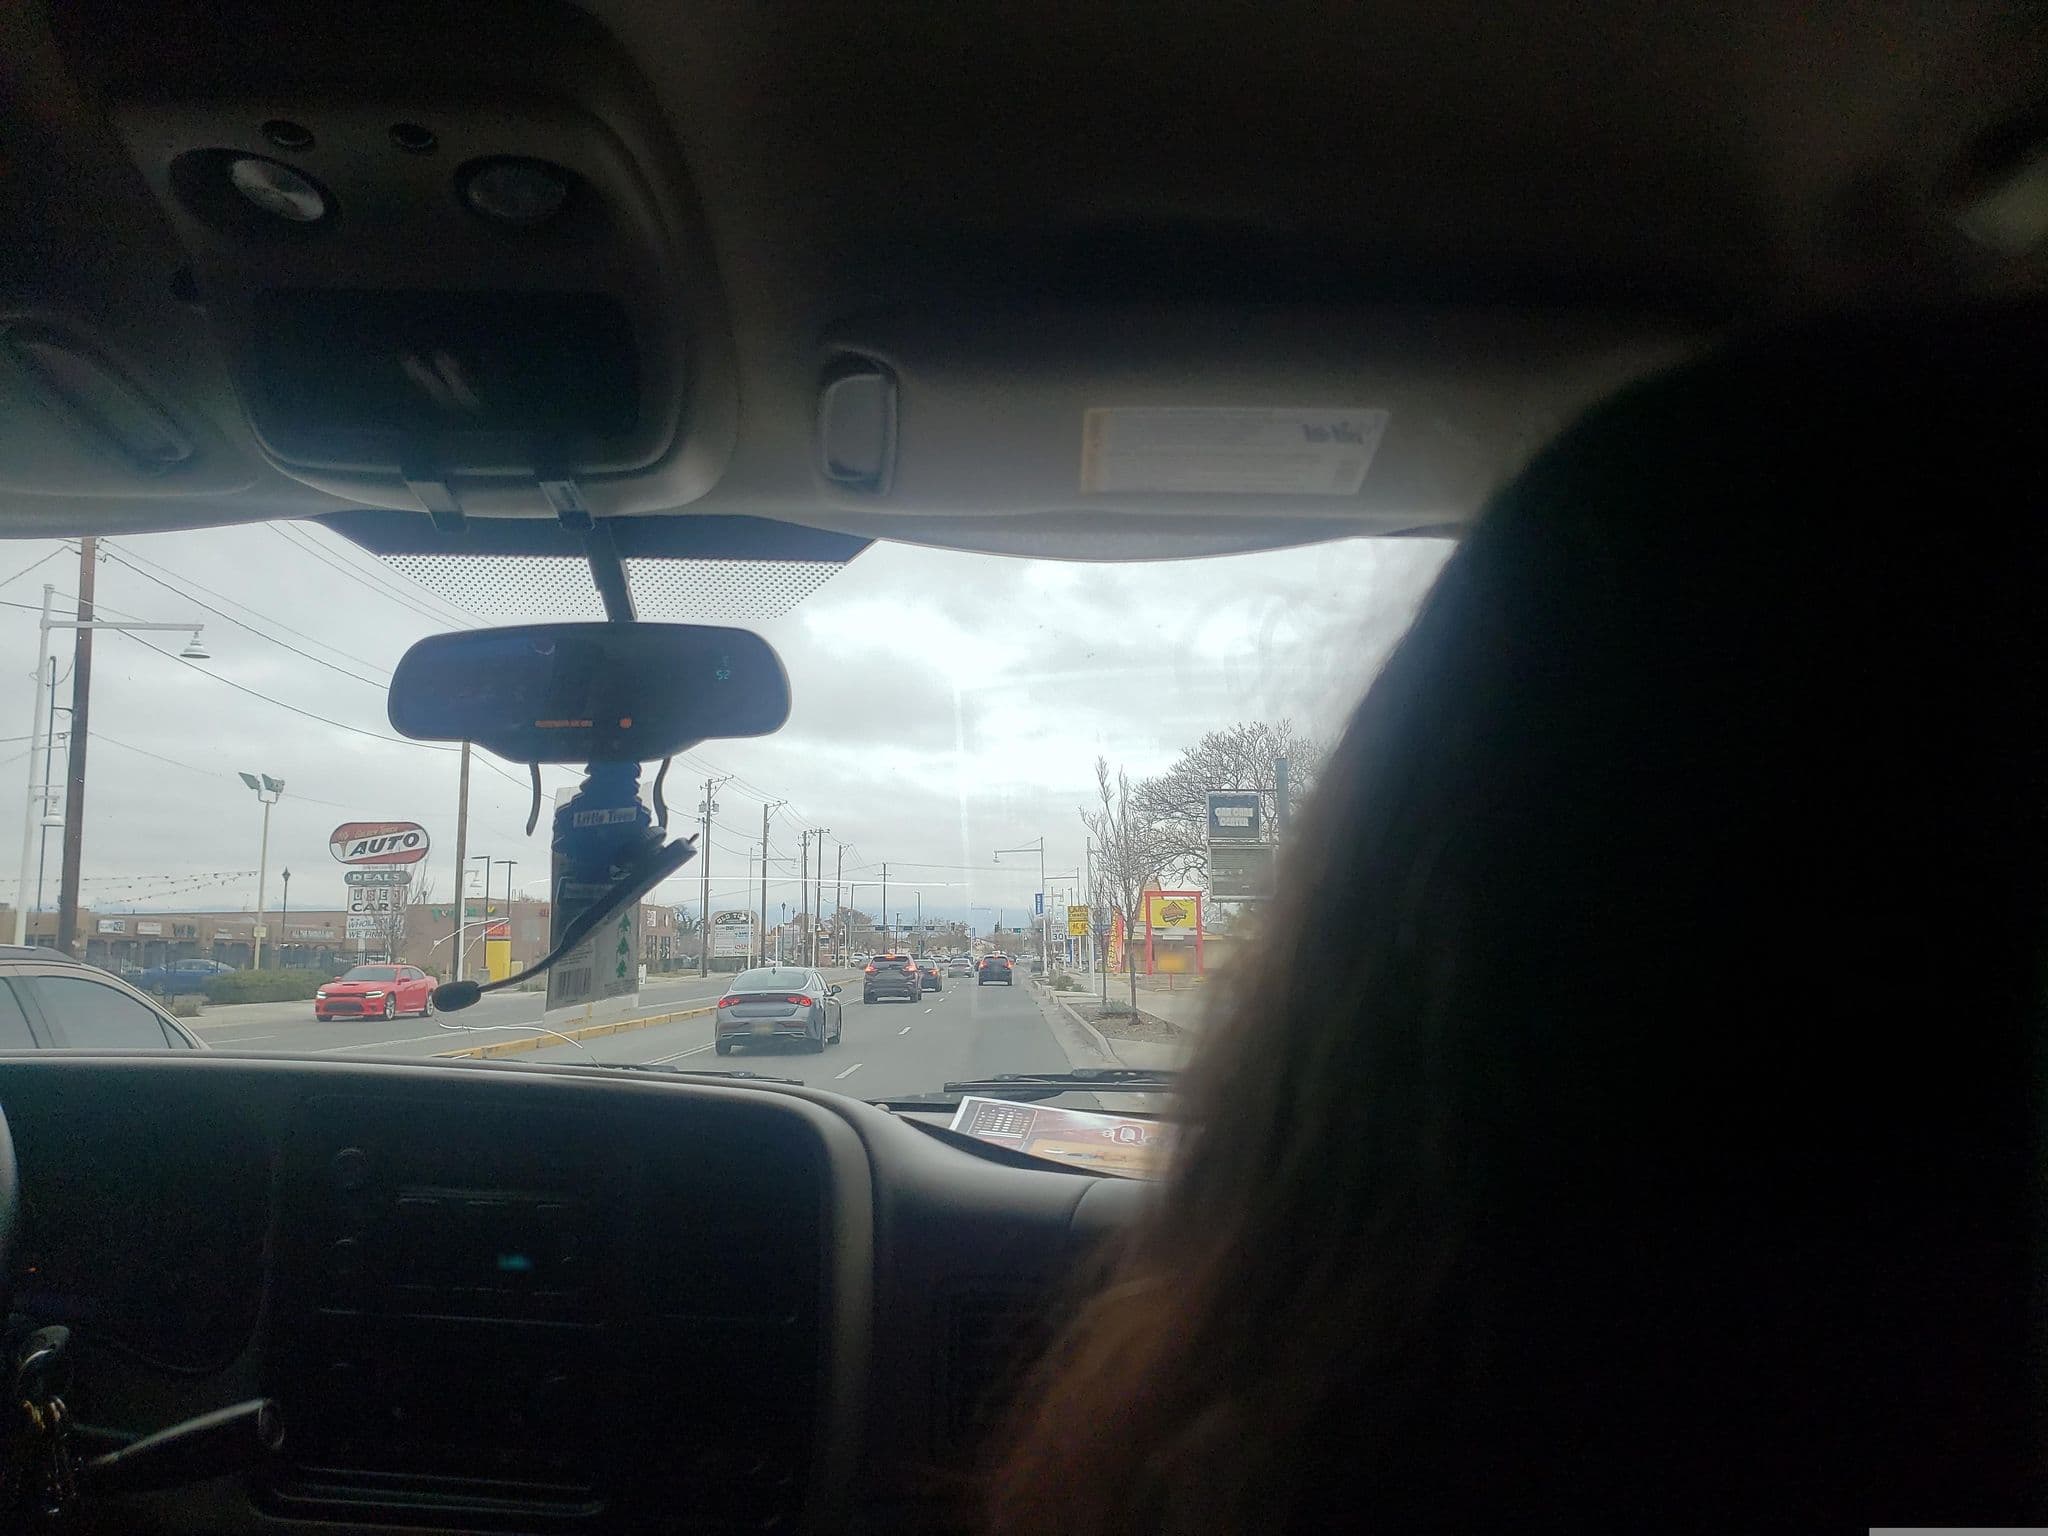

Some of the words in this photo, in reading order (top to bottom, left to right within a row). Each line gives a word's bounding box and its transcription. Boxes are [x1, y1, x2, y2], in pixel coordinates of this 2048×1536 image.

[348, 832, 420, 857] AUTO
[351, 873, 401, 881] DEALS
[351, 902, 402, 912] CARS
[1052, 933, 1064, 941] 30
